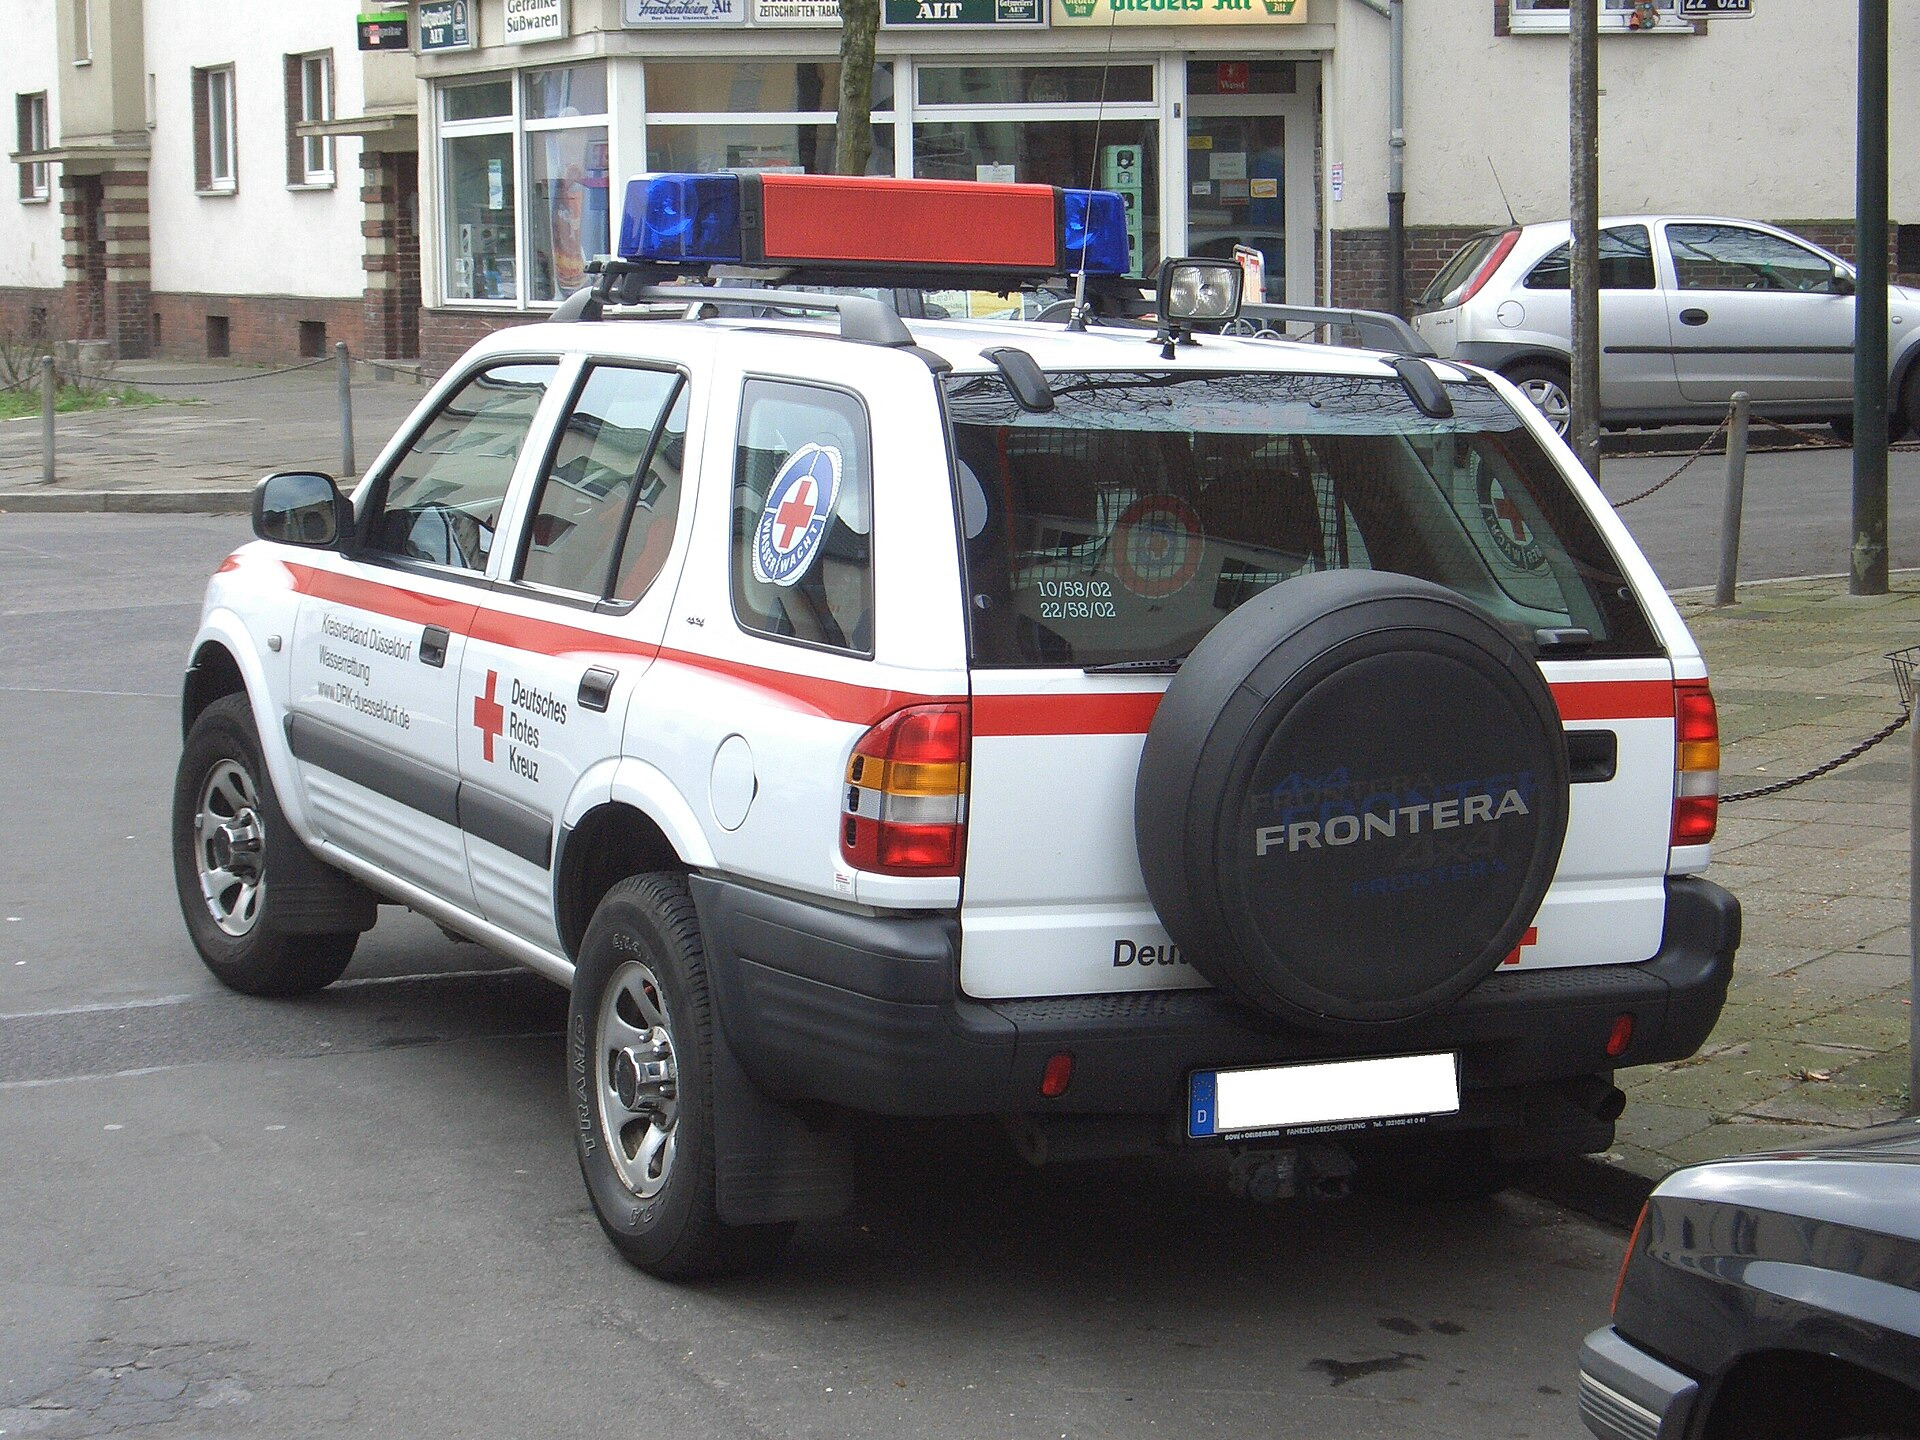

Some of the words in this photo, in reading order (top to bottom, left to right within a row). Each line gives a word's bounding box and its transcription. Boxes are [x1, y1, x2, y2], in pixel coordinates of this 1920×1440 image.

[914, 2, 963, 19] ALT
[761, 516, 778, 573] WASSER
[780, 523, 818, 574] WACHT
[1037, 581, 1113, 599] 10/58/02
[1040, 601, 1117, 620] 22/58/02
[321, 612, 369, 648] Kreisverband
[369, 627, 413, 662] Düsseldorf
[319, 643, 371, 687] Wasserrettung
[511, 678, 567, 725] Deutsches
[509, 711, 540, 749] Rotes
[509, 744, 539, 783] Kreuz
[1255, 789, 1530, 857] FRONTERA
[1113, 939, 1189, 968] Deu
[1197, 1110, 1207, 1123] D
